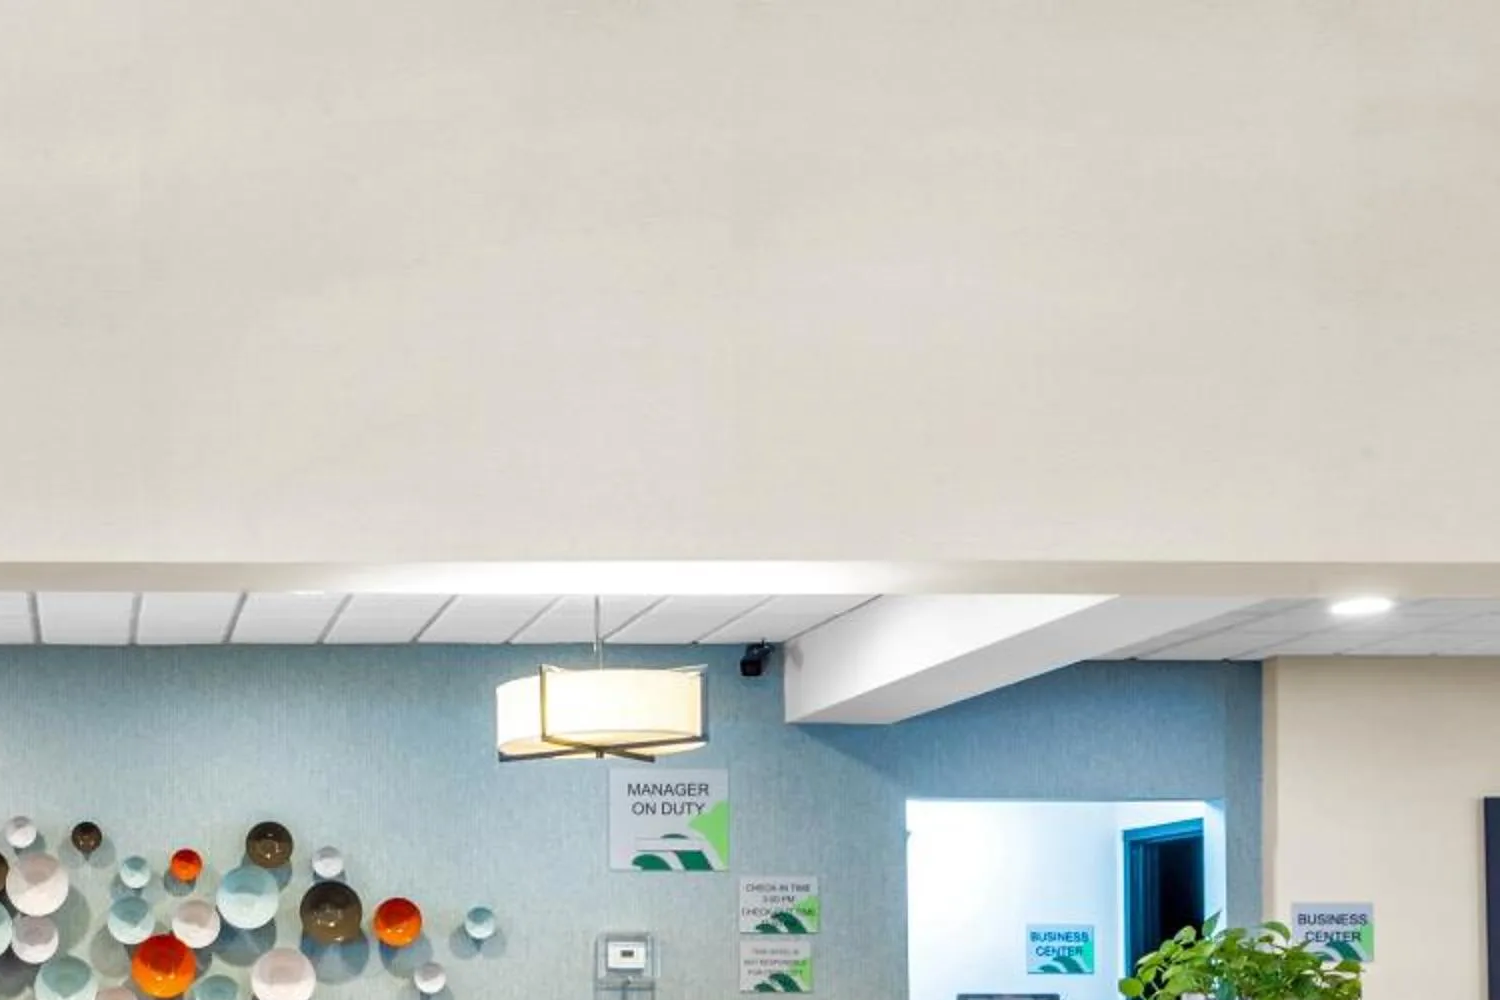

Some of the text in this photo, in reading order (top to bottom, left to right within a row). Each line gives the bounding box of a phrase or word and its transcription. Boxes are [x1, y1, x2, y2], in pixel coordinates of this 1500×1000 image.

[627, 783, 709, 797] MANAGER
[631, 801, 706, 816] ON DUTY
[1297, 912, 1368, 926] BUSINESS
[1029, 931, 1089, 943] BUSINESS
[1305, 930, 1362, 943] CENTER
[1035, 945, 1084, 957] CENTER
